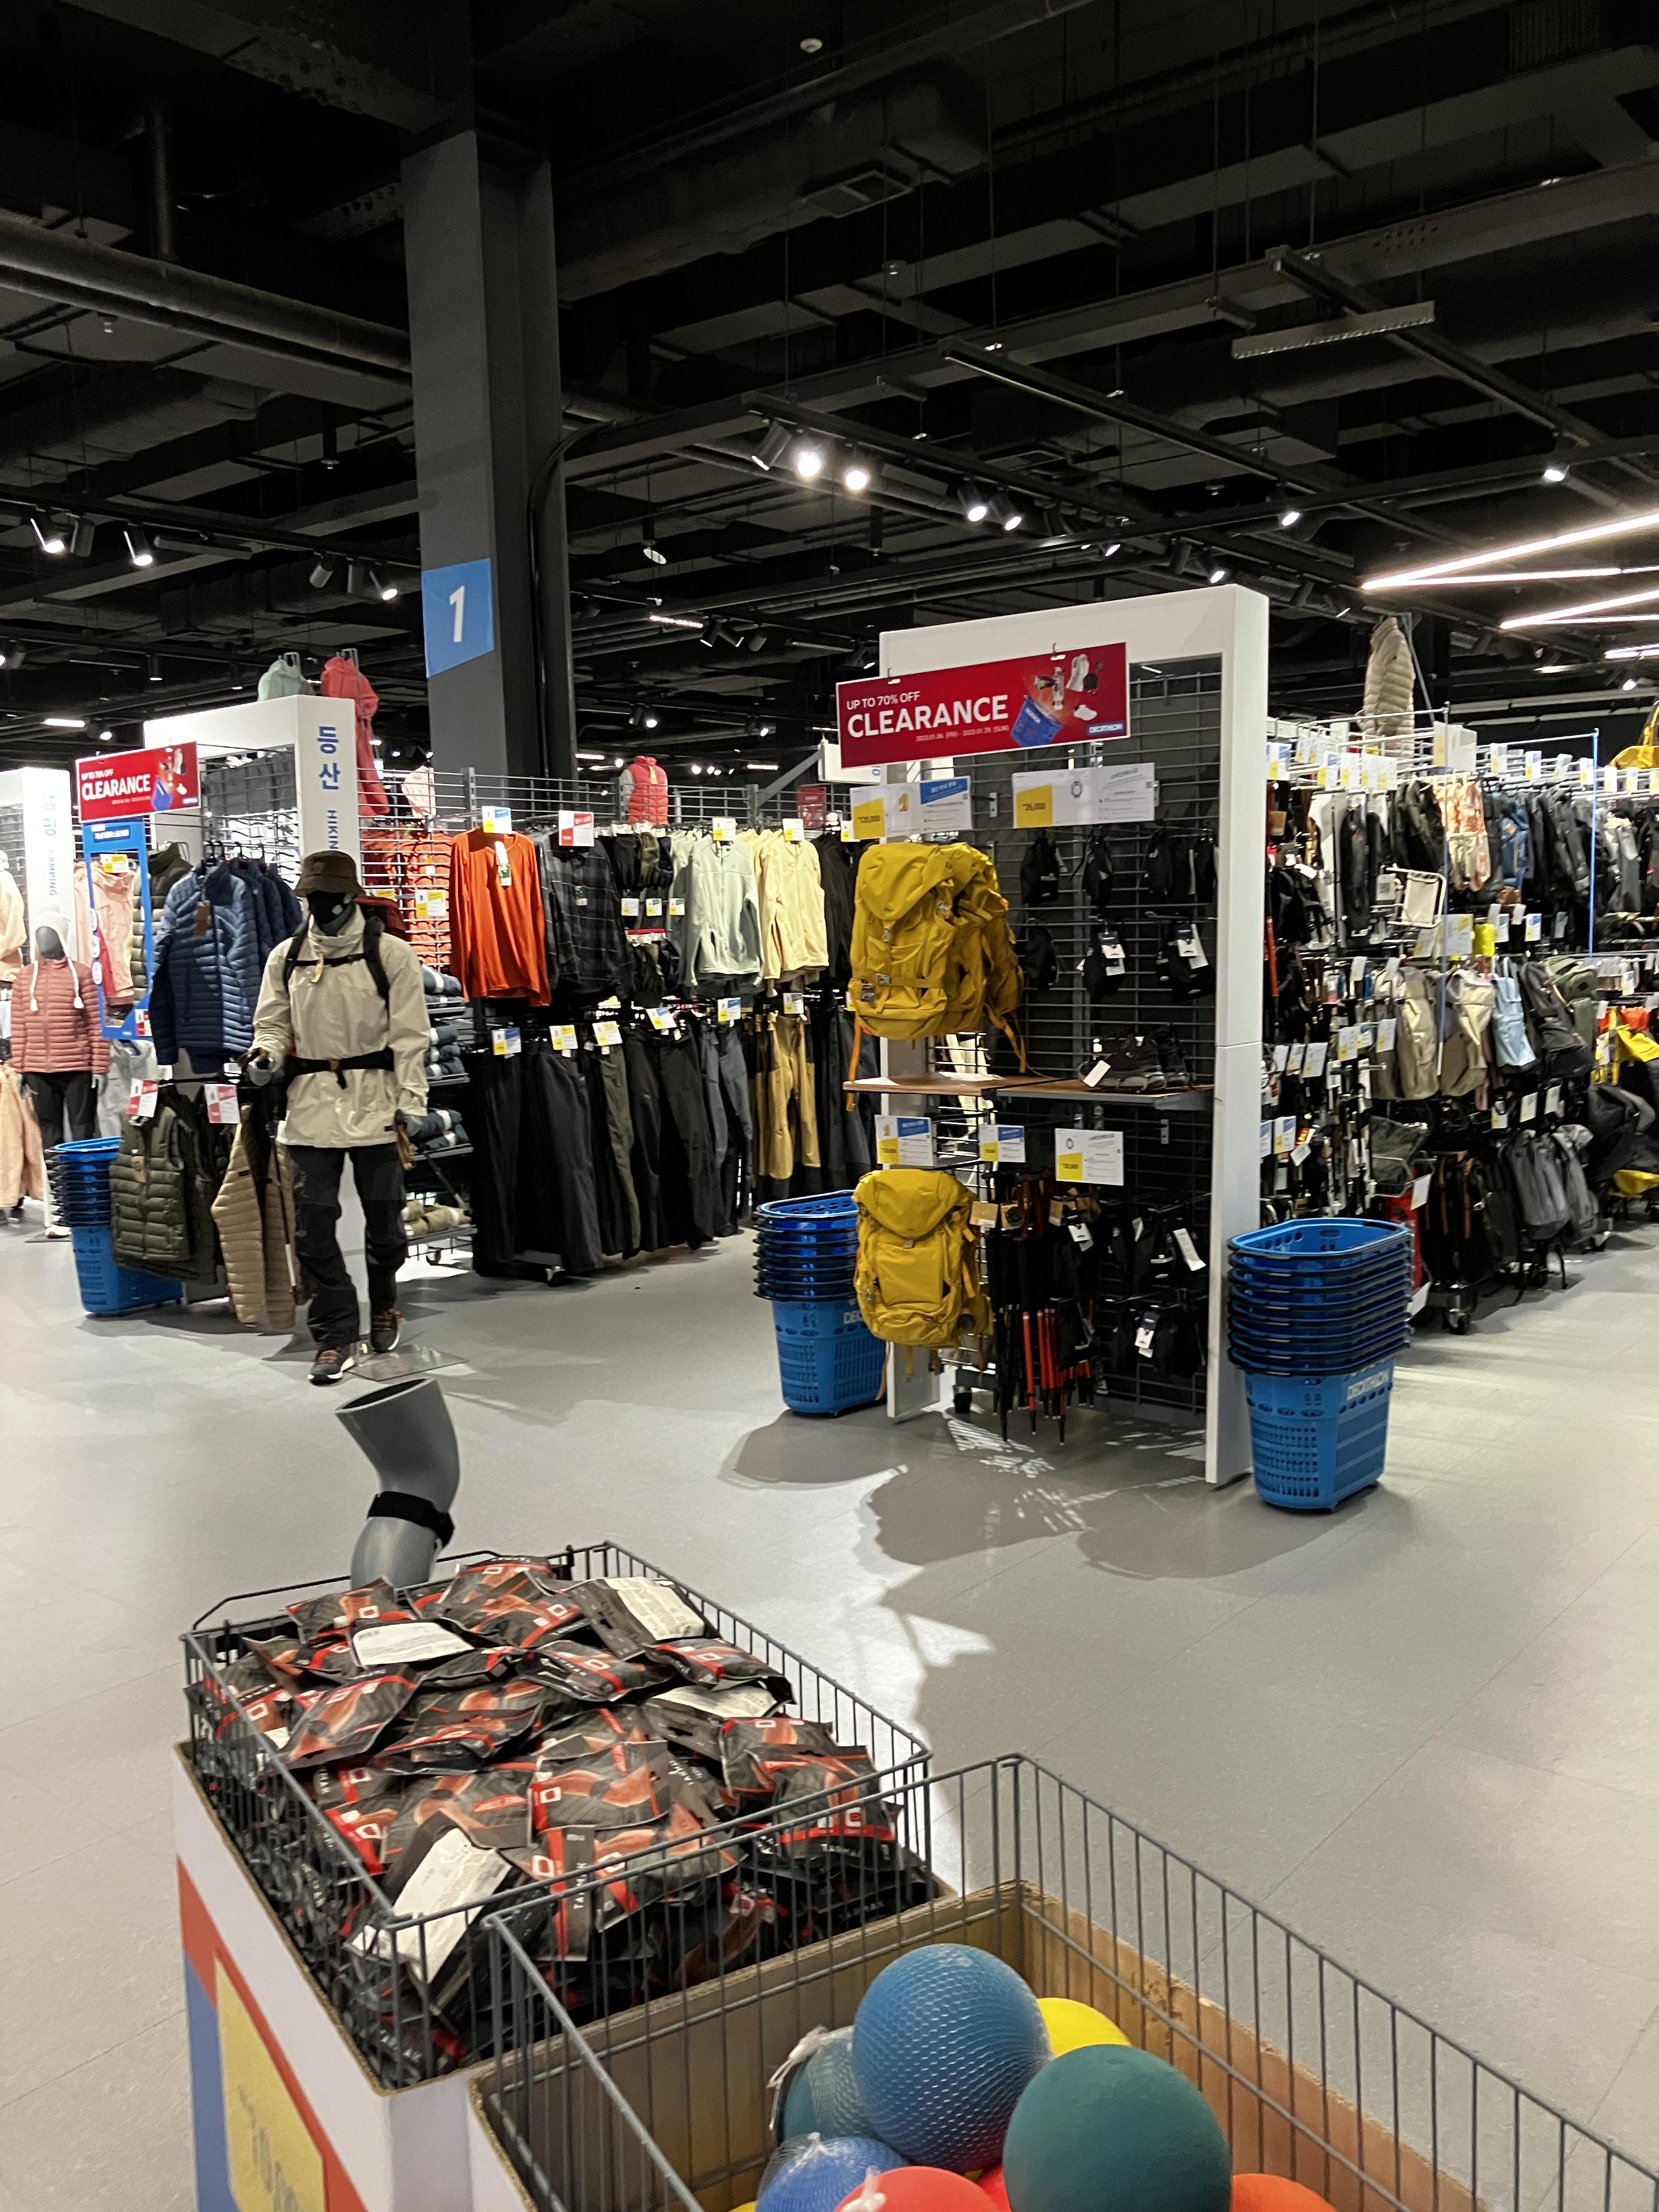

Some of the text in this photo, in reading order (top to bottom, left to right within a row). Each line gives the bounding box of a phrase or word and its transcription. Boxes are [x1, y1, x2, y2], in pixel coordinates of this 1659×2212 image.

[449, 585, 465, 642] 1
[847, 691, 921, 710] UP TO 70% OFF
[847, 694, 1009, 738] CLEARANCE
[82, 774, 151, 800] CLEARANCE
[326, 810, 339, 850] HIKIN
[573, 1862, 588, 1910] TAMAK
